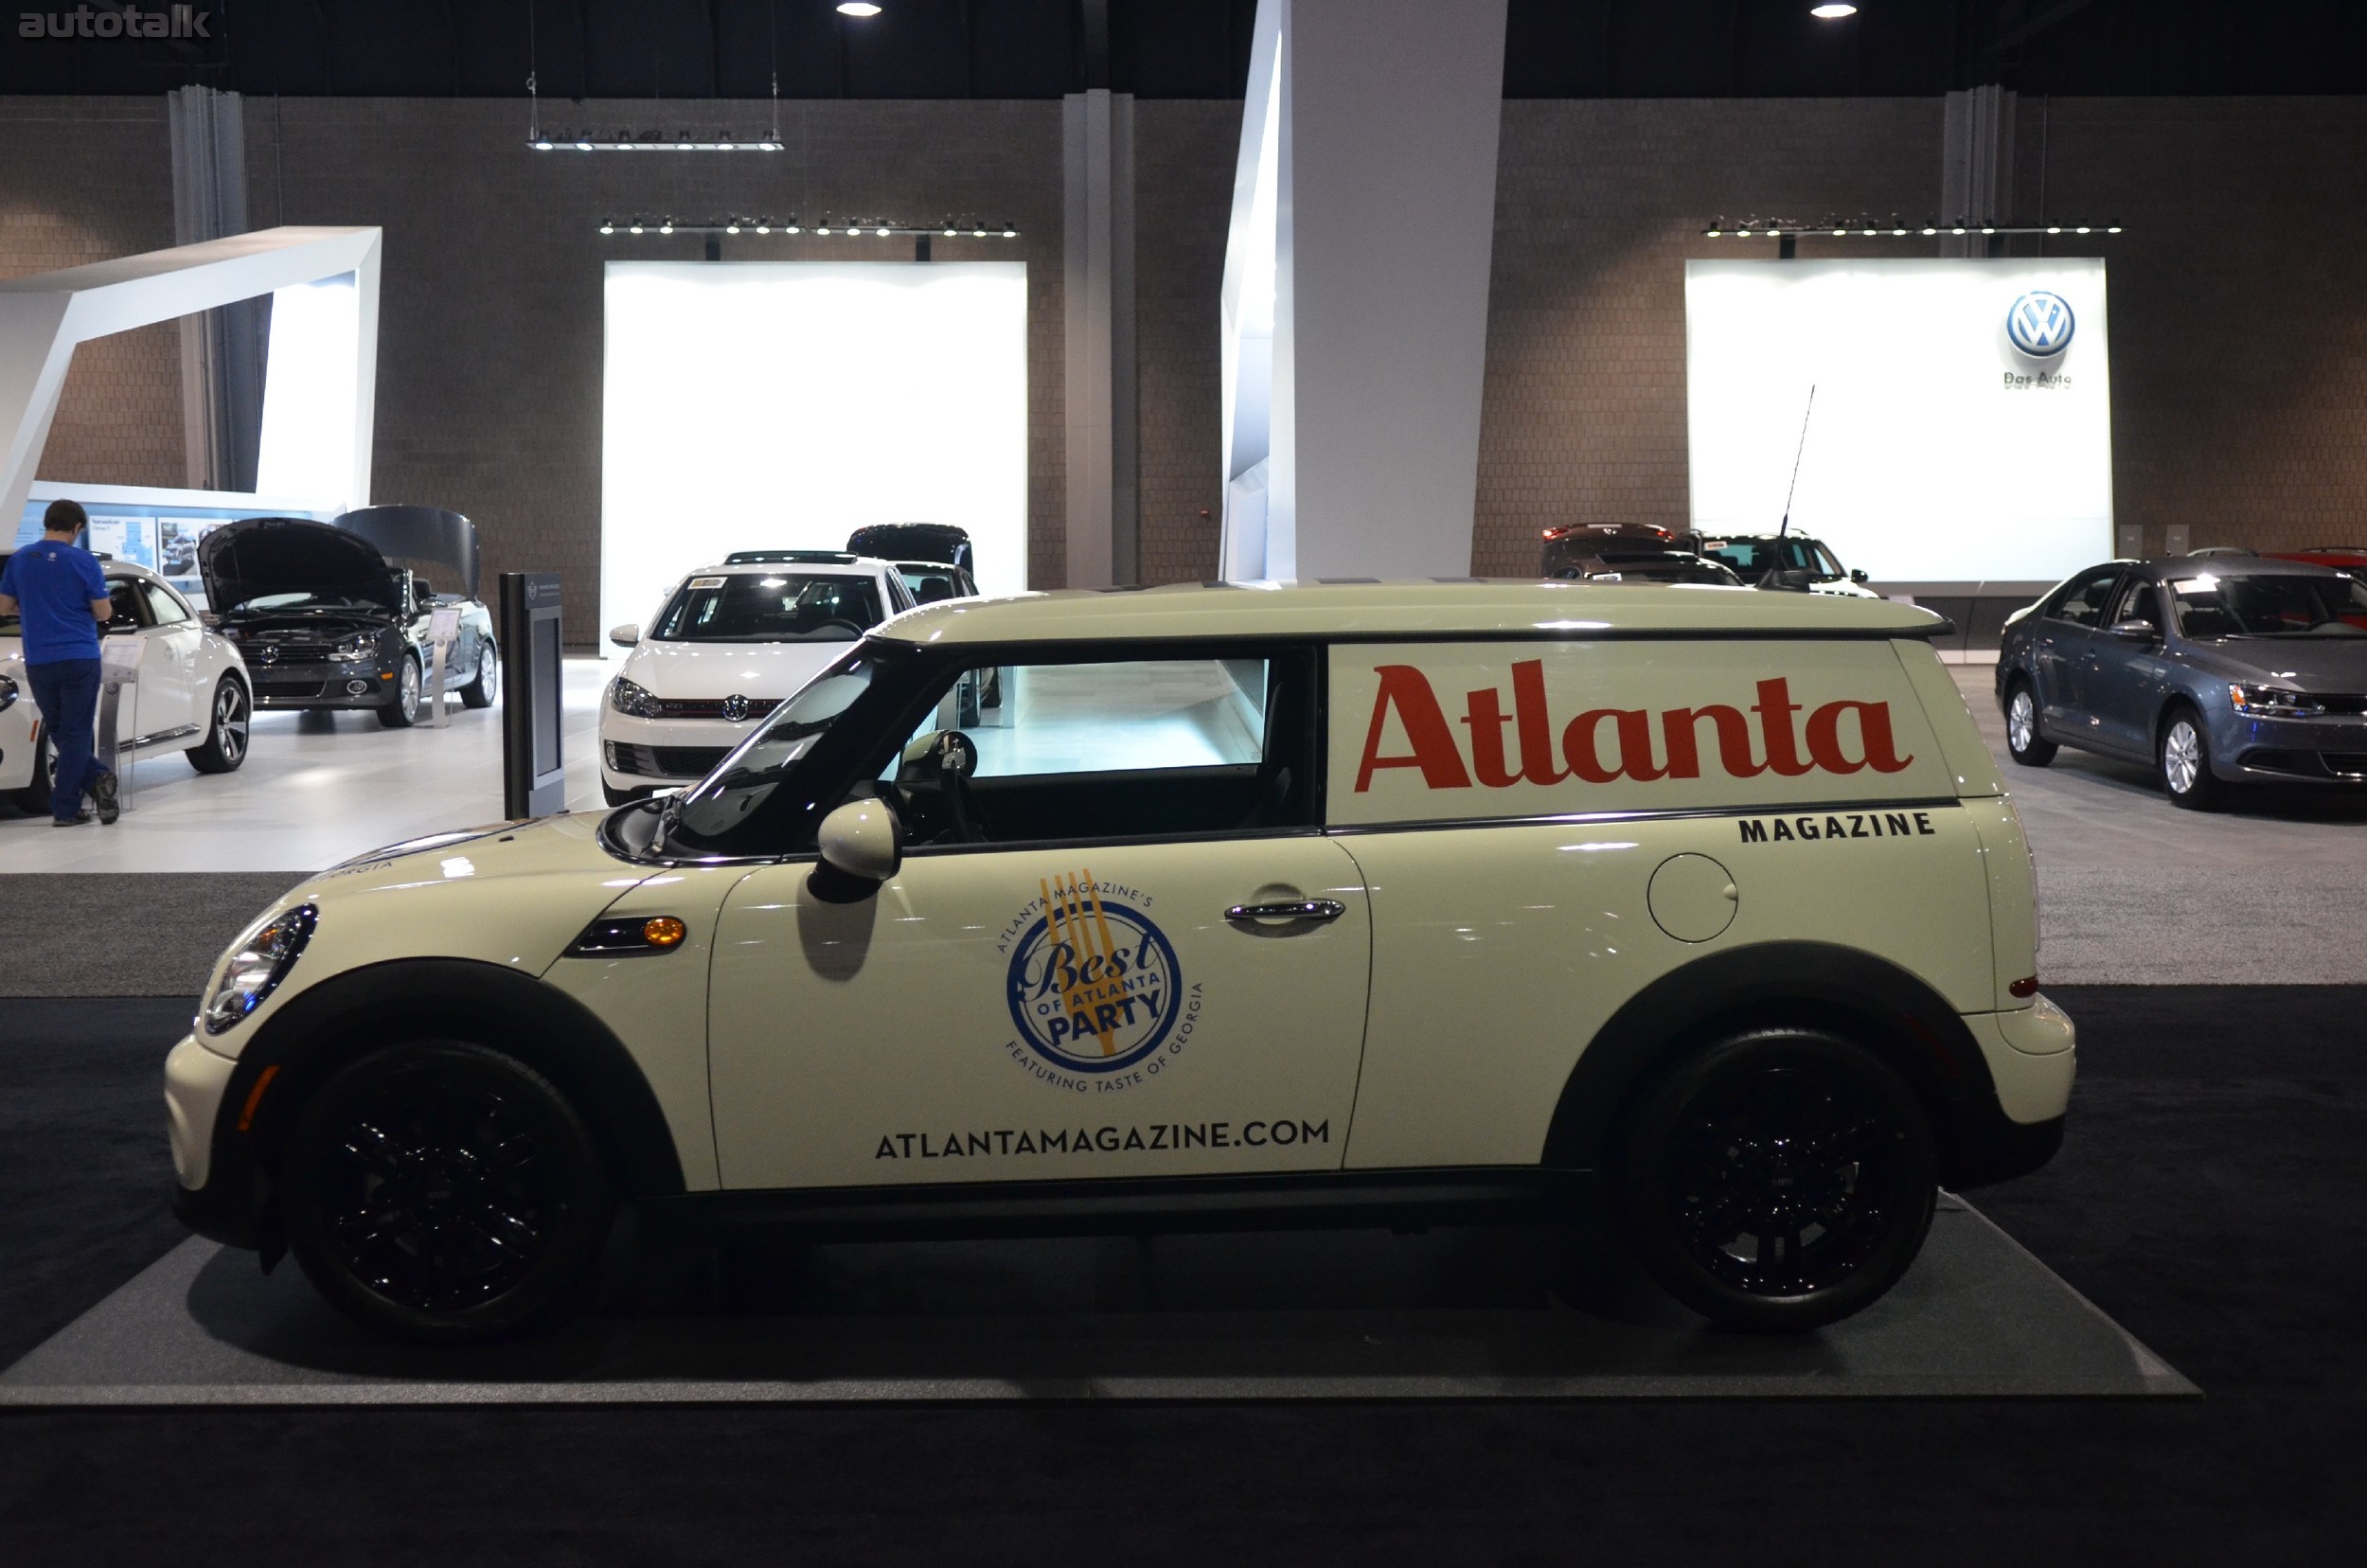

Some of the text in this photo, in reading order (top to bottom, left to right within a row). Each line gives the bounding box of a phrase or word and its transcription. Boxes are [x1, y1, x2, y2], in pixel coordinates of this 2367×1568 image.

[2004, 372, 2072, 384] Das Auto
[1354, 659, 1914, 793] Atlanta
[1738, 811, 1936, 843] MAGAZINE
[997, 882, 1153, 953] ATLANTA MAGAZINE'S
[1019, 932, 1161, 1002] Best
[1037, 971, 1160, 1016] OF ATLANTA
[1006, 982, 1203, 1093] FEATURING TASTE OF GEORGIA
[1047, 989, 1161, 1046] PARTY
[875, 1118, 1329, 1160] ATLANTAMAGAZINE.COM
